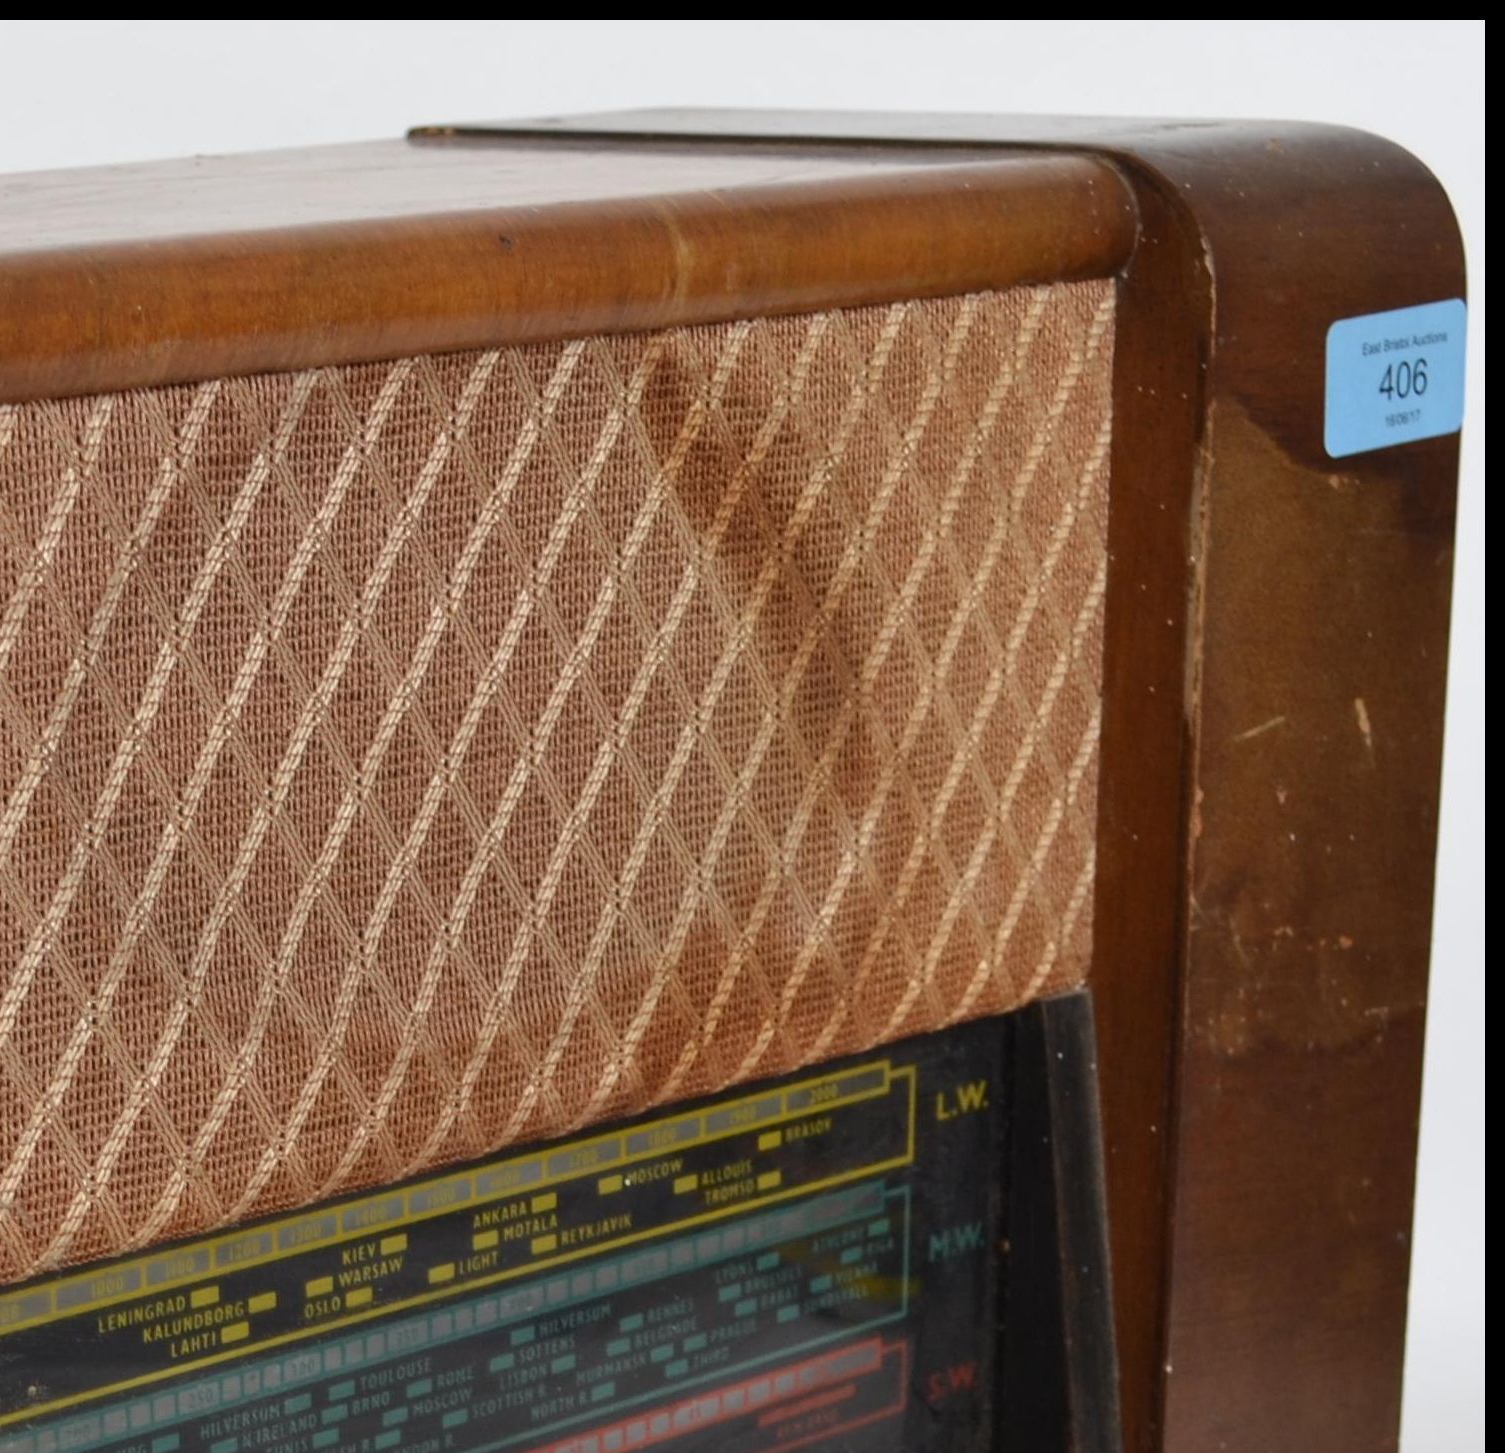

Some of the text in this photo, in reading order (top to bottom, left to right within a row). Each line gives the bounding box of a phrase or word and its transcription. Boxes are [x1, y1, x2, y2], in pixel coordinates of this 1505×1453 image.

[1412, 332, 1448, 346] Auctions
[1379, 358, 1428, 400] 406
[937, 1080, 989, 1120] L.W.
[625, 1156, 683, 1188] MOSCOW
[473, 1199, 526, 1231] ANKARA
[503, 1212, 557, 1243] MOTALA
[561, 1211, 631, 1247] REYKJAVIK
[342, 1241, 375, 1267] KIEV
[929, 1222, 985, 1262] M.W.
[339, 1255, 402, 1289] WARSAW
[459, 1249, 498, 1276] LIGHT
[97, 1293, 185, 1335] LENINGRAD
[142, 1300, 243, 1344] KALUNDBORG
[304, 1293, 340, 1320] OSLO
[538, 1301, 611, 1339] HILVERSUM
[170, 1328, 216, 1359] LAHTI
[519, 1333, 575, 1364] SOTTENS
[360, 1356, 431, 1393] TOULOUSE
[437, 1364, 474, 1390] ROME
[499, 1362, 547, 1392] LISBON
[575, 1351, 645, 1388] MURMANSK
[352, 1390, 390, 1416] BRNO
[412, 1385, 473, 1419] MOSCOW
[471, 1386, 533, 1420] SCOTTISH
[530, 1393, 574, 1422] NORTH
[200, 1401, 280, 1441] HILVERSUM
